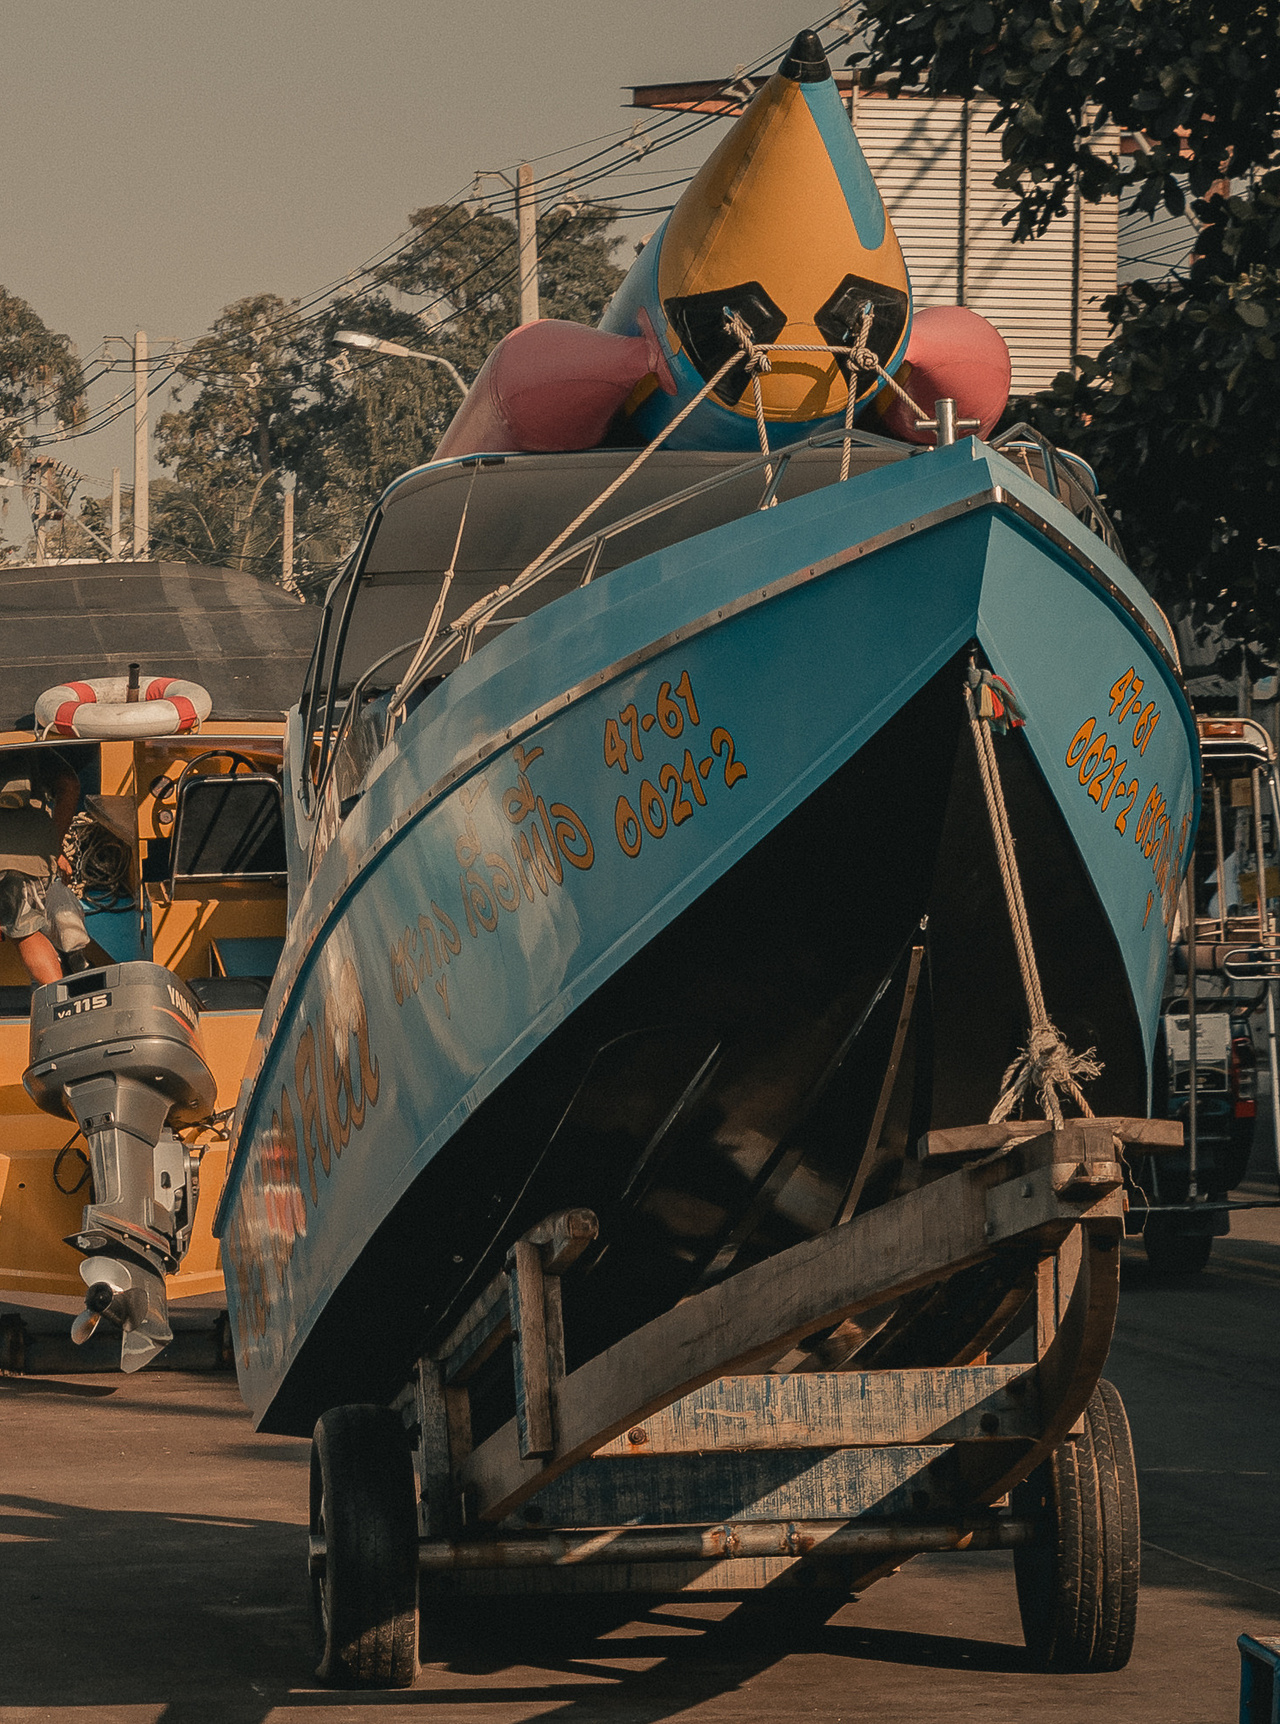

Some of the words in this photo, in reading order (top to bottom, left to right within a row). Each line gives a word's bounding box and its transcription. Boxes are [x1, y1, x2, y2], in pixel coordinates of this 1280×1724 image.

[602, 669, 701, 774] 47-61
[1108, 665, 1161, 757] 47-61
[613, 725, 749, 859] 0021-2
[1064, 716, 1139, 836] 0021-2
[57, 1009, 72, 1020] V4
[73, 994, 109, 1015] 115
